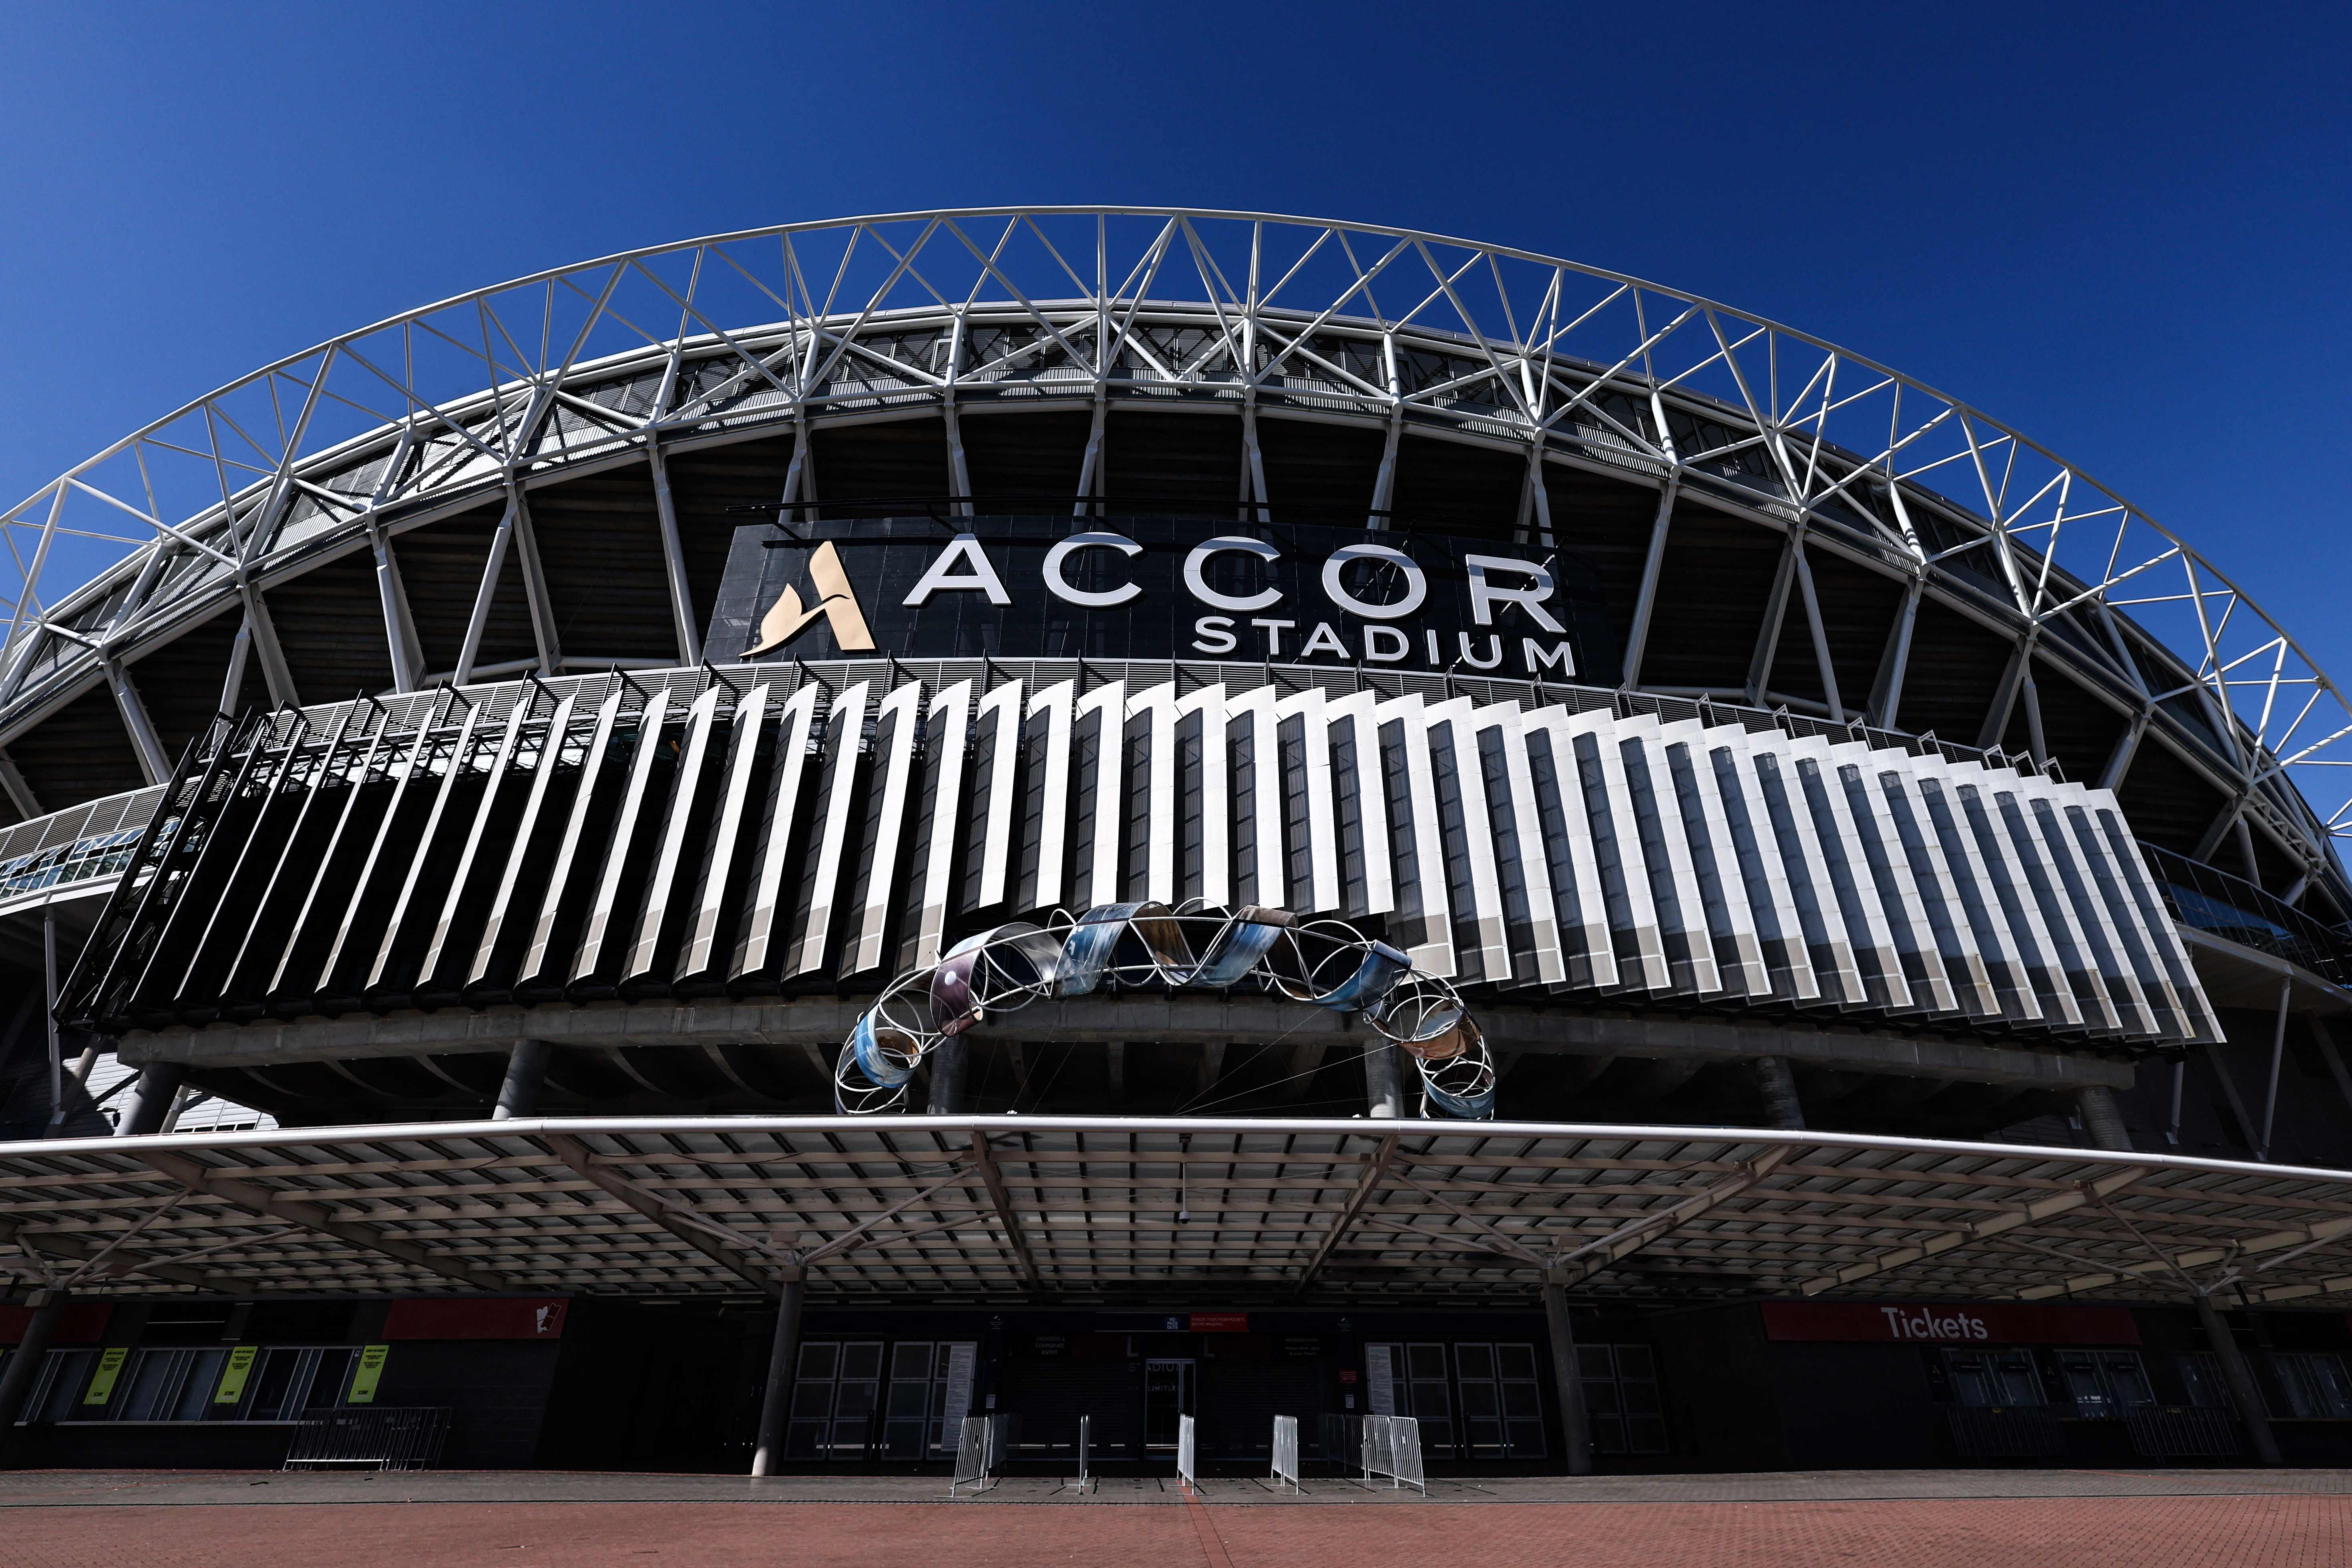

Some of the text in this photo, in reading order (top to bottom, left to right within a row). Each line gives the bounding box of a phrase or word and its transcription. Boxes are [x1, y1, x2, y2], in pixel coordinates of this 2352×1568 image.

[902, 532, 1567, 633] ACCOR
[1192, 616, 1576, 677] STADIUM
[1880, 1307, 1988, 1339] Tickets
